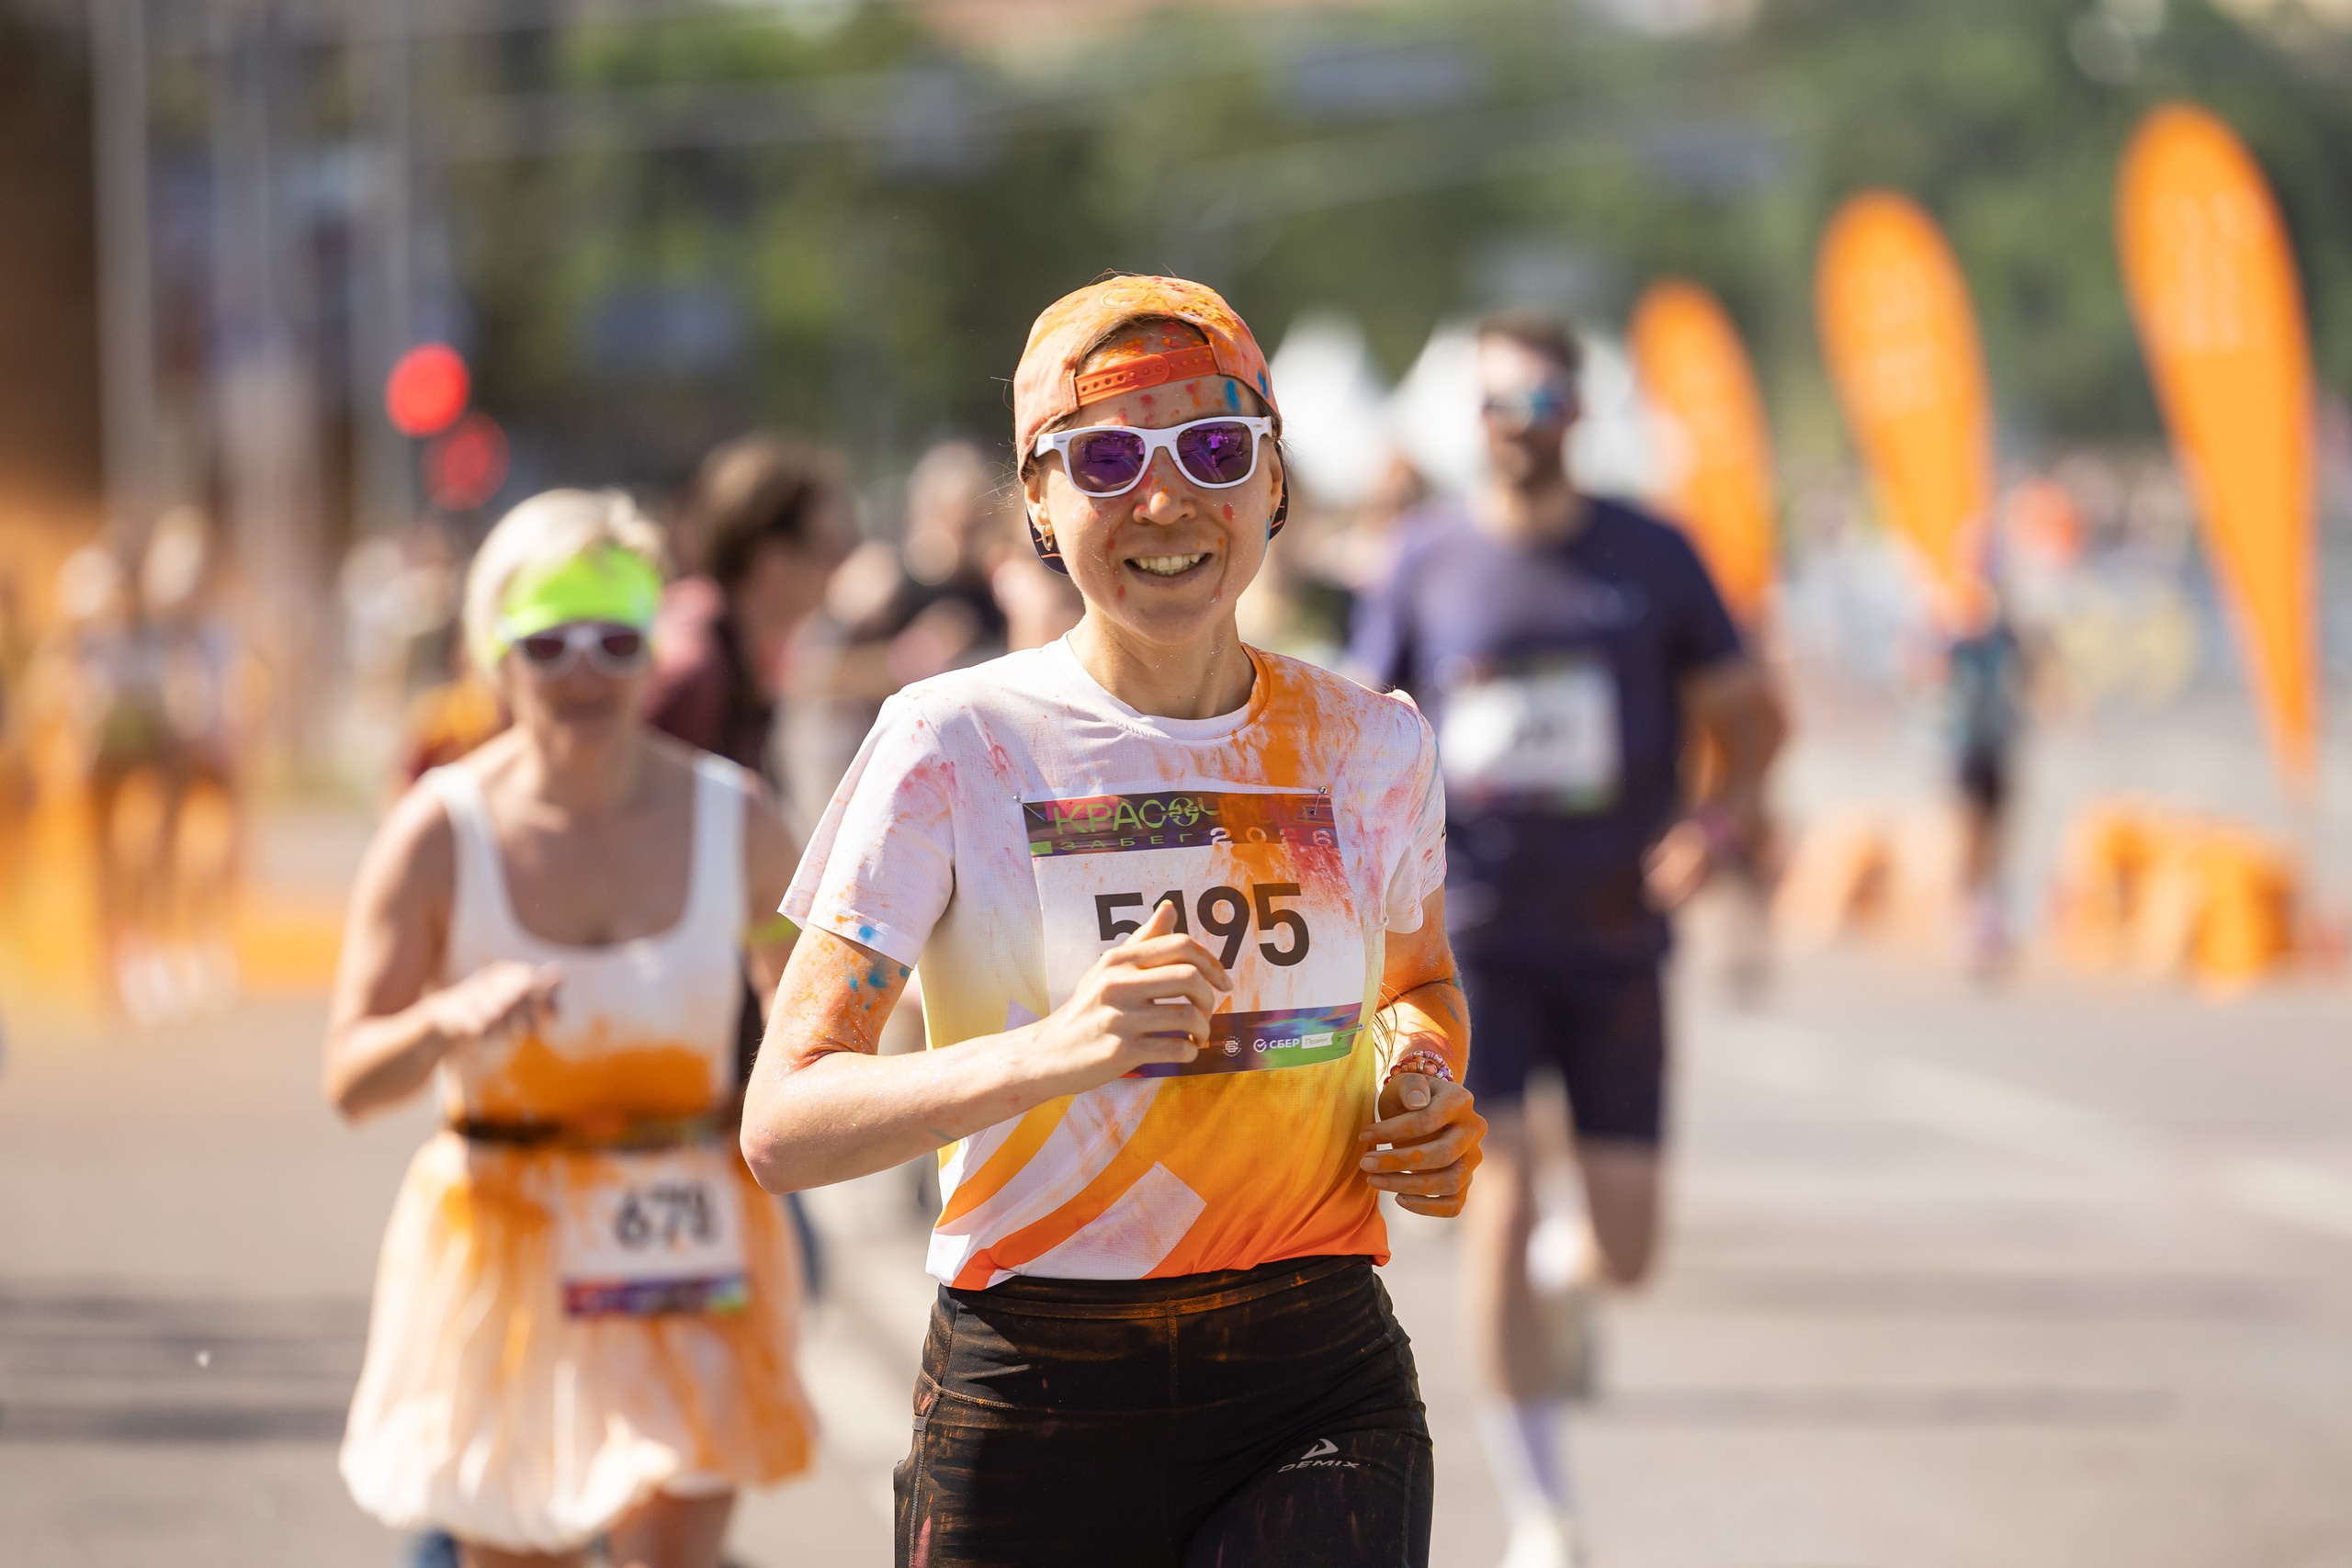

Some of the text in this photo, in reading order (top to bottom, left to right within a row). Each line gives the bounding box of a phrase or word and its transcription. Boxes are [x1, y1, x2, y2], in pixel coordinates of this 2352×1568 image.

[1059, 833, 1193, 851] ЗАБЕГ
[1269, 1038, 1300, 1049] СБЕР
[1277, 1460, 1360, 1473] DEMIX
